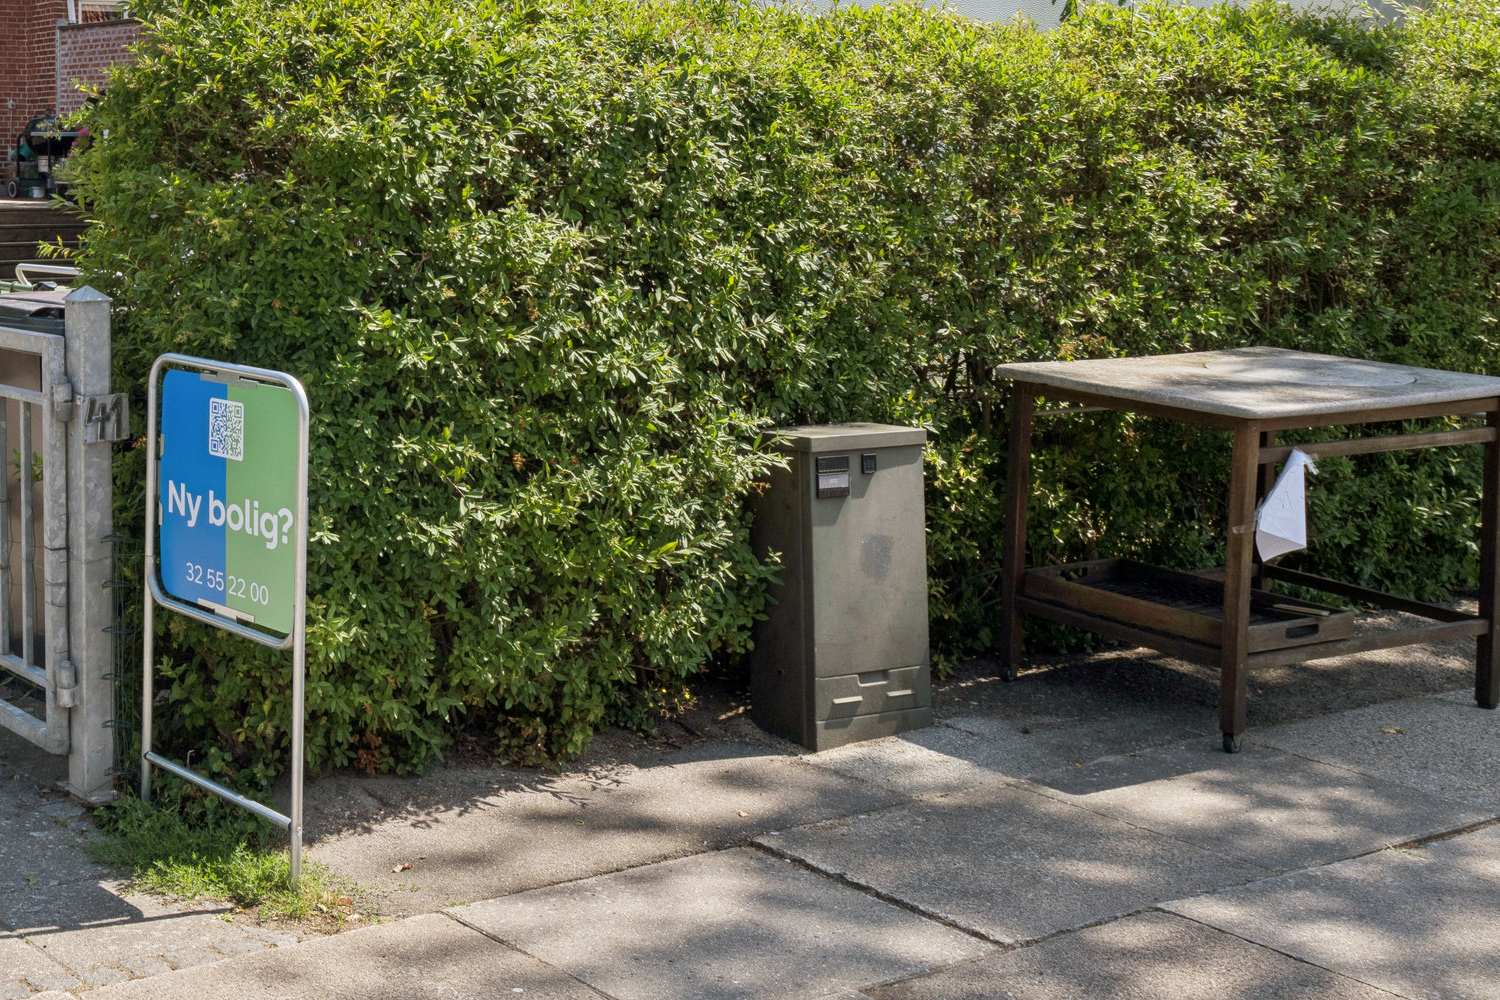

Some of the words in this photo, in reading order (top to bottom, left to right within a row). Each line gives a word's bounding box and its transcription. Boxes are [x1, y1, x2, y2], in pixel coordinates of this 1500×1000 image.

[85, 395, 123, 441] 41
[168, 479, 202, 528] Ny
[208, 489, 294, 550] bolig?
[185, 562, 203, 585] 32
[206, 568, 224, 591] 55
[228, 575, 246, 599] 22
[250, 582, 269, 605] 00
